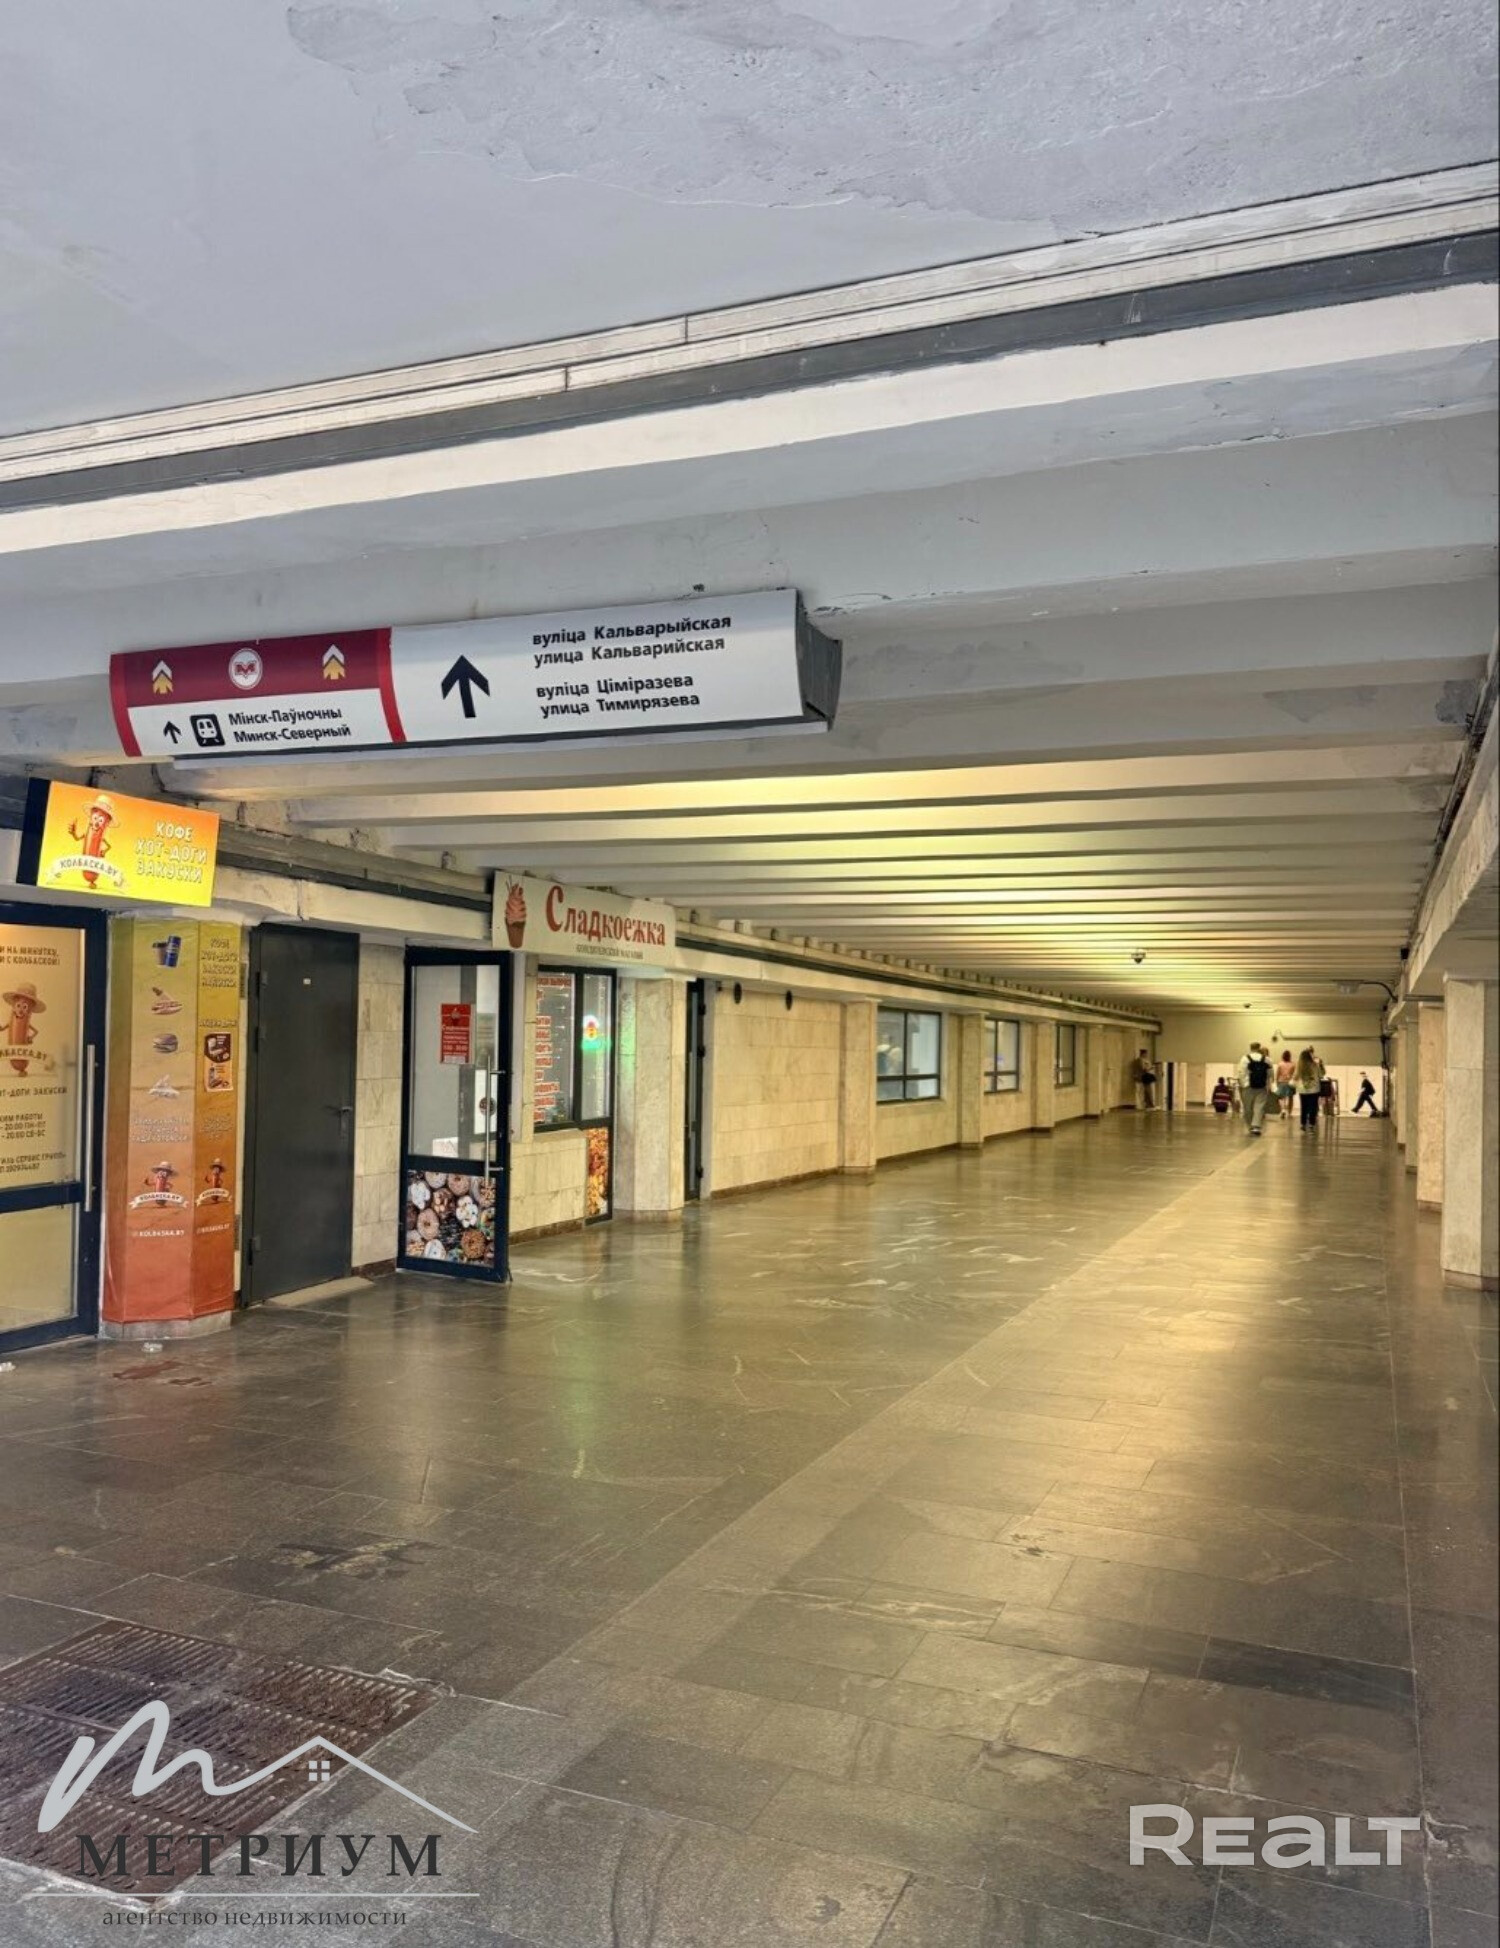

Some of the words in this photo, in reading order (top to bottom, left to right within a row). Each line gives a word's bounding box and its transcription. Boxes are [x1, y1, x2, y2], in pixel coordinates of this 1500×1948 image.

[532, 628, 586, 648] вуліца
[594, 616, 732, 640] Кальварыйская
[534, 649, 584, 668] улица
[591, 638, 725, 660] Кальварийская
[536, 682, 590, 701] вуліца
[596, 675, 694, 696] Ціміразева
[228, 708, 342, 725] Мінск-Паўночны
[540, 701, 590, 719] улица
[596, 694, 701, 712] Тимирязева
[233, 724, 351, 743] Минск-Северный
[155, 821, 193, 843] КОФЕ
[135, 838, 208, 866] ХОТ-ДОГИ
[137, 859, 203, 884] ЗАКУСКИ
[546, 885, 666, 946] Сладкоежка
